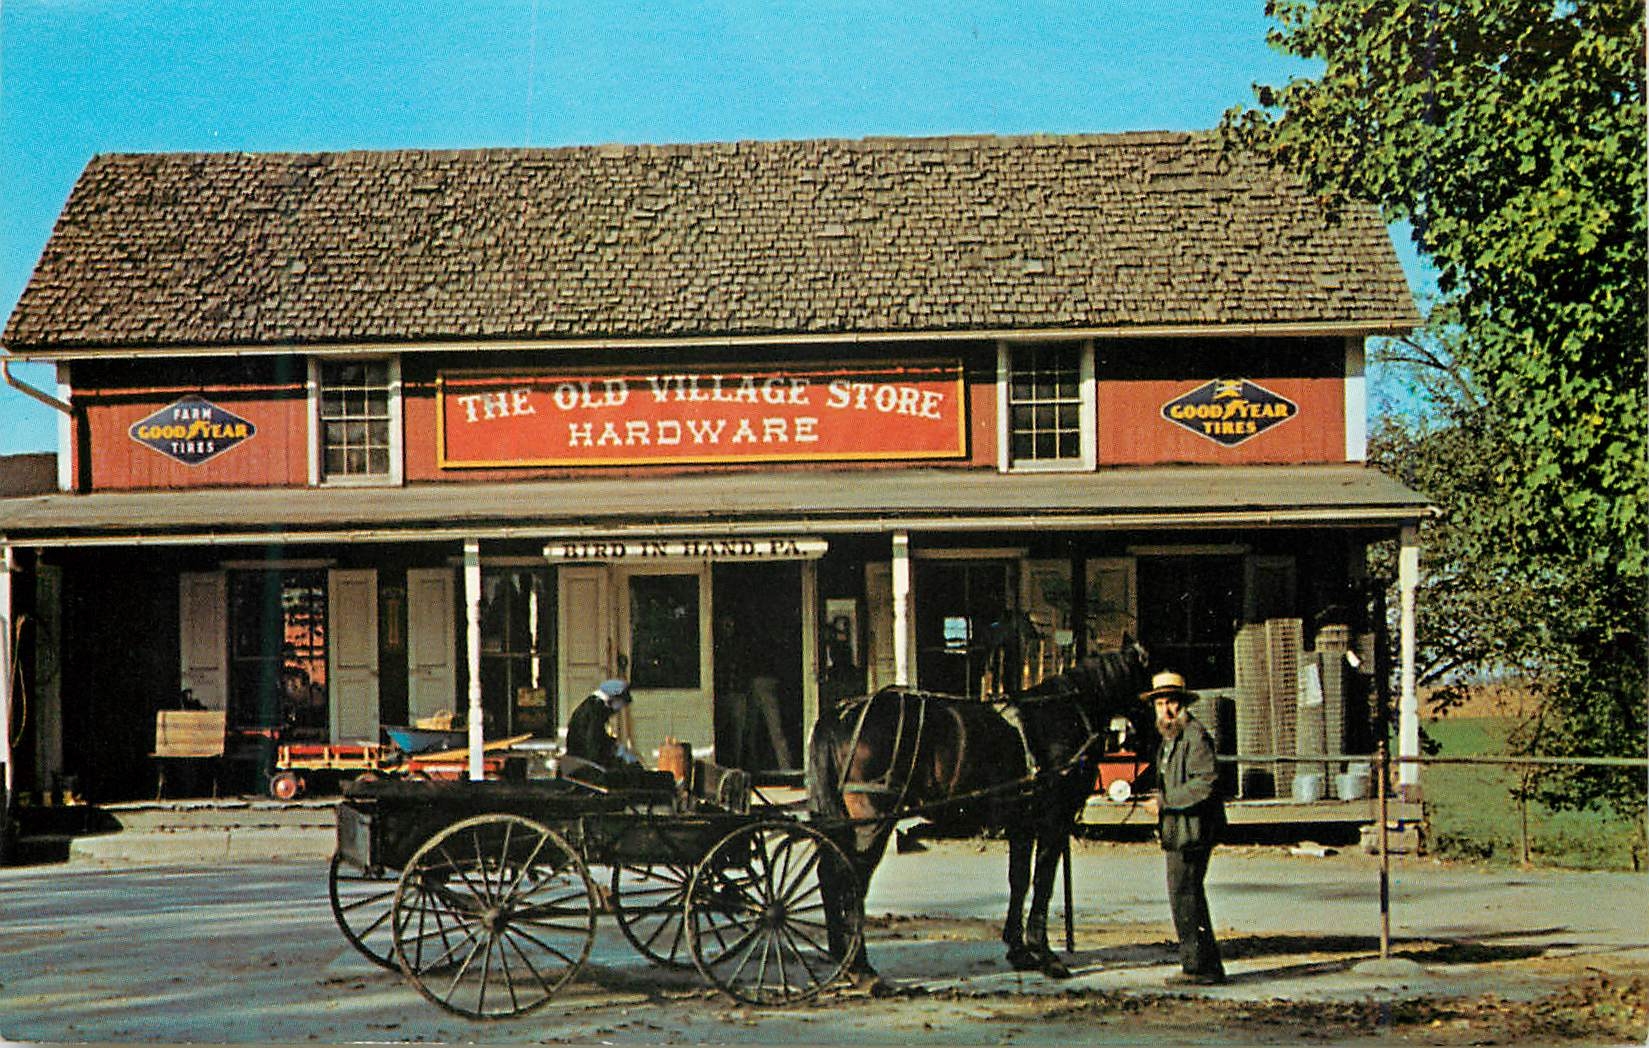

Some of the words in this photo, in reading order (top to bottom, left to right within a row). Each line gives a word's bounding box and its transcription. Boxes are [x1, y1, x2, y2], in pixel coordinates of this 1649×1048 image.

[458, 387, 536, 424] THE
[553, 377, 631, 411] OLD
[648, 374, 811, 406] VILLAGE
[827, 379, 945, 421] STORE
[173, 408, 213, 421] FARM
[568, 417, 820, 447] HARDWARE
[1203, 421, 1258, 435] TIRES
[171, 442, 215, 455] TIRES
[563, 543, 626, 559] BIRD
[641, 542, 668, 557] IN
